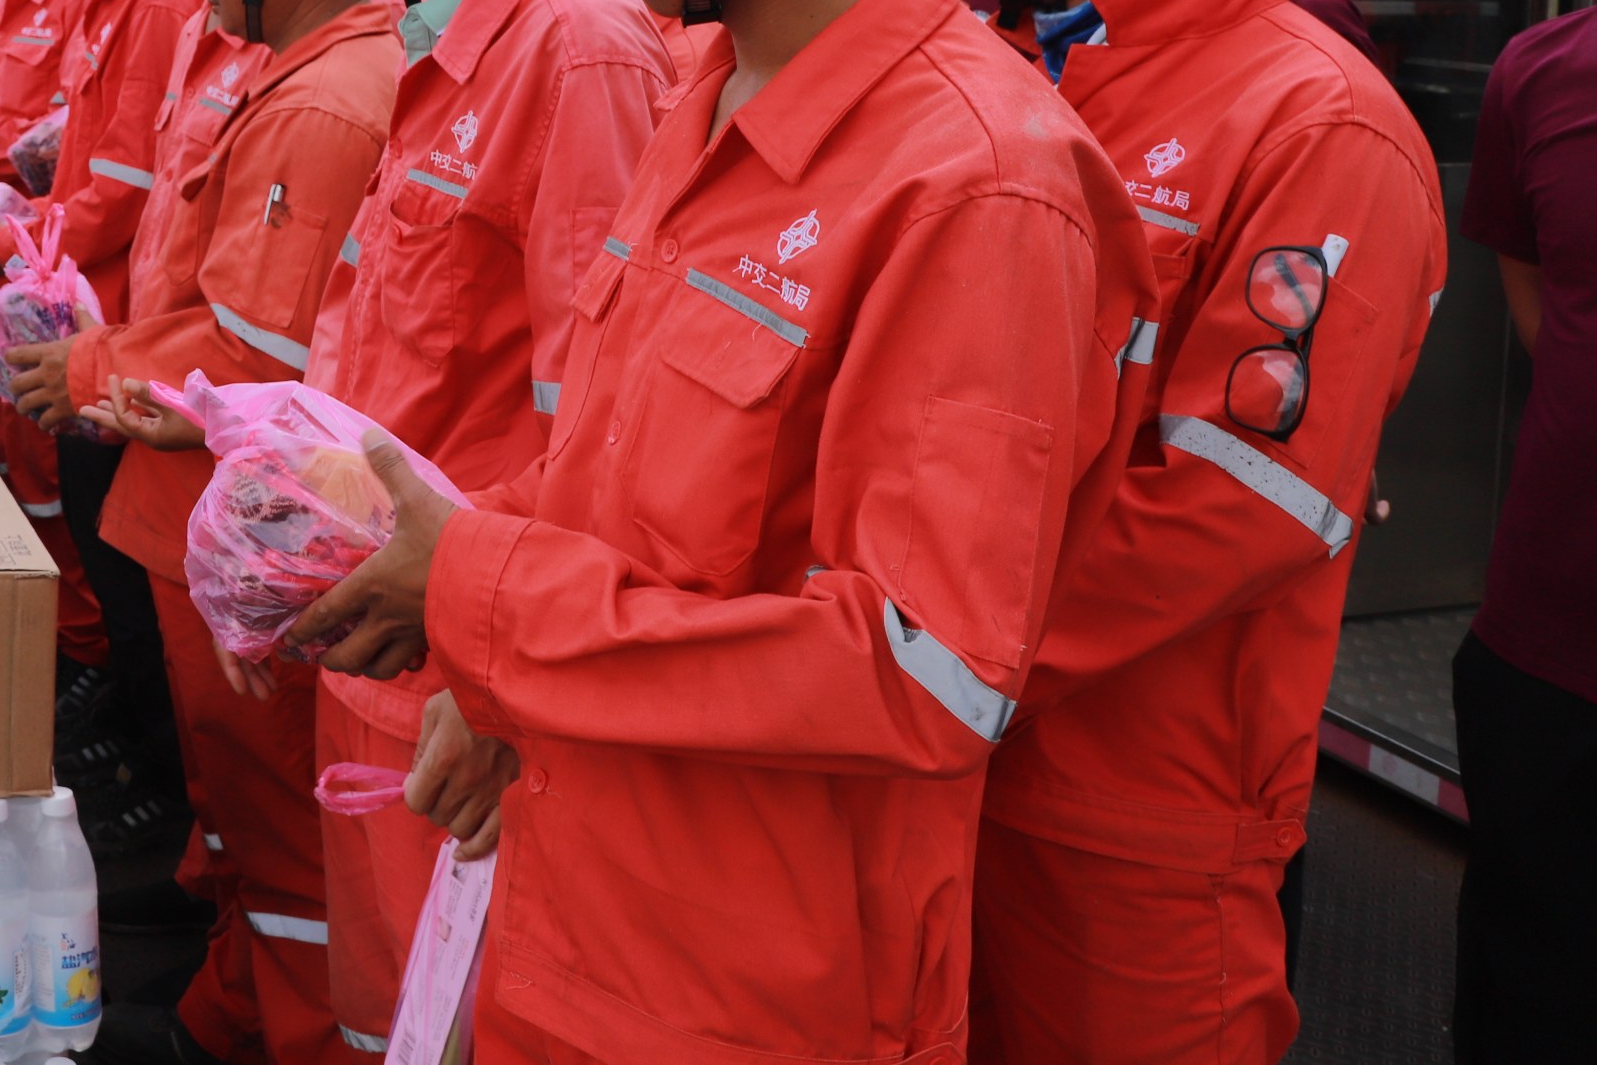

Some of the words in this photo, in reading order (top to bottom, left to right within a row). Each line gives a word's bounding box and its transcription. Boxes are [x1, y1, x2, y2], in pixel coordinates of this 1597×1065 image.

[738, 253, 811, 311] 中交二航局
